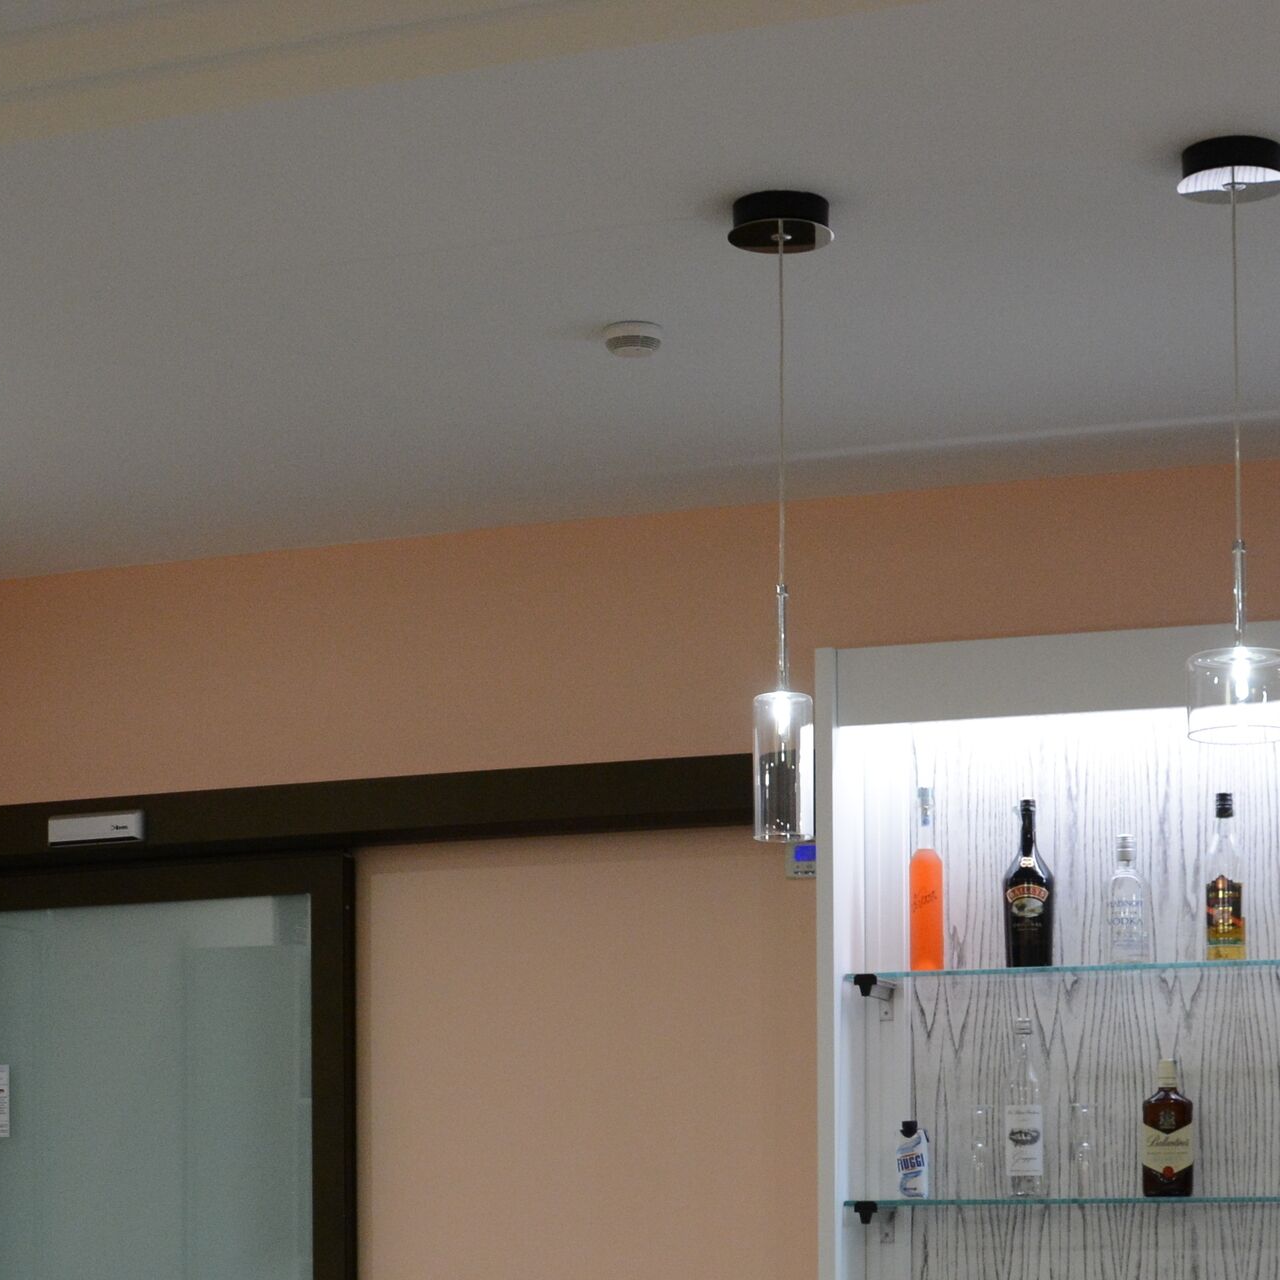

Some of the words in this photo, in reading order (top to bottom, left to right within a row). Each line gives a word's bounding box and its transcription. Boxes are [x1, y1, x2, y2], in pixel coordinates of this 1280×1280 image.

[1009, 885, 1046, 900] BAILEYS
[1106, 917, 1144, 926] VODKA
[896, 1153, 926, 1173] FIUGGI
